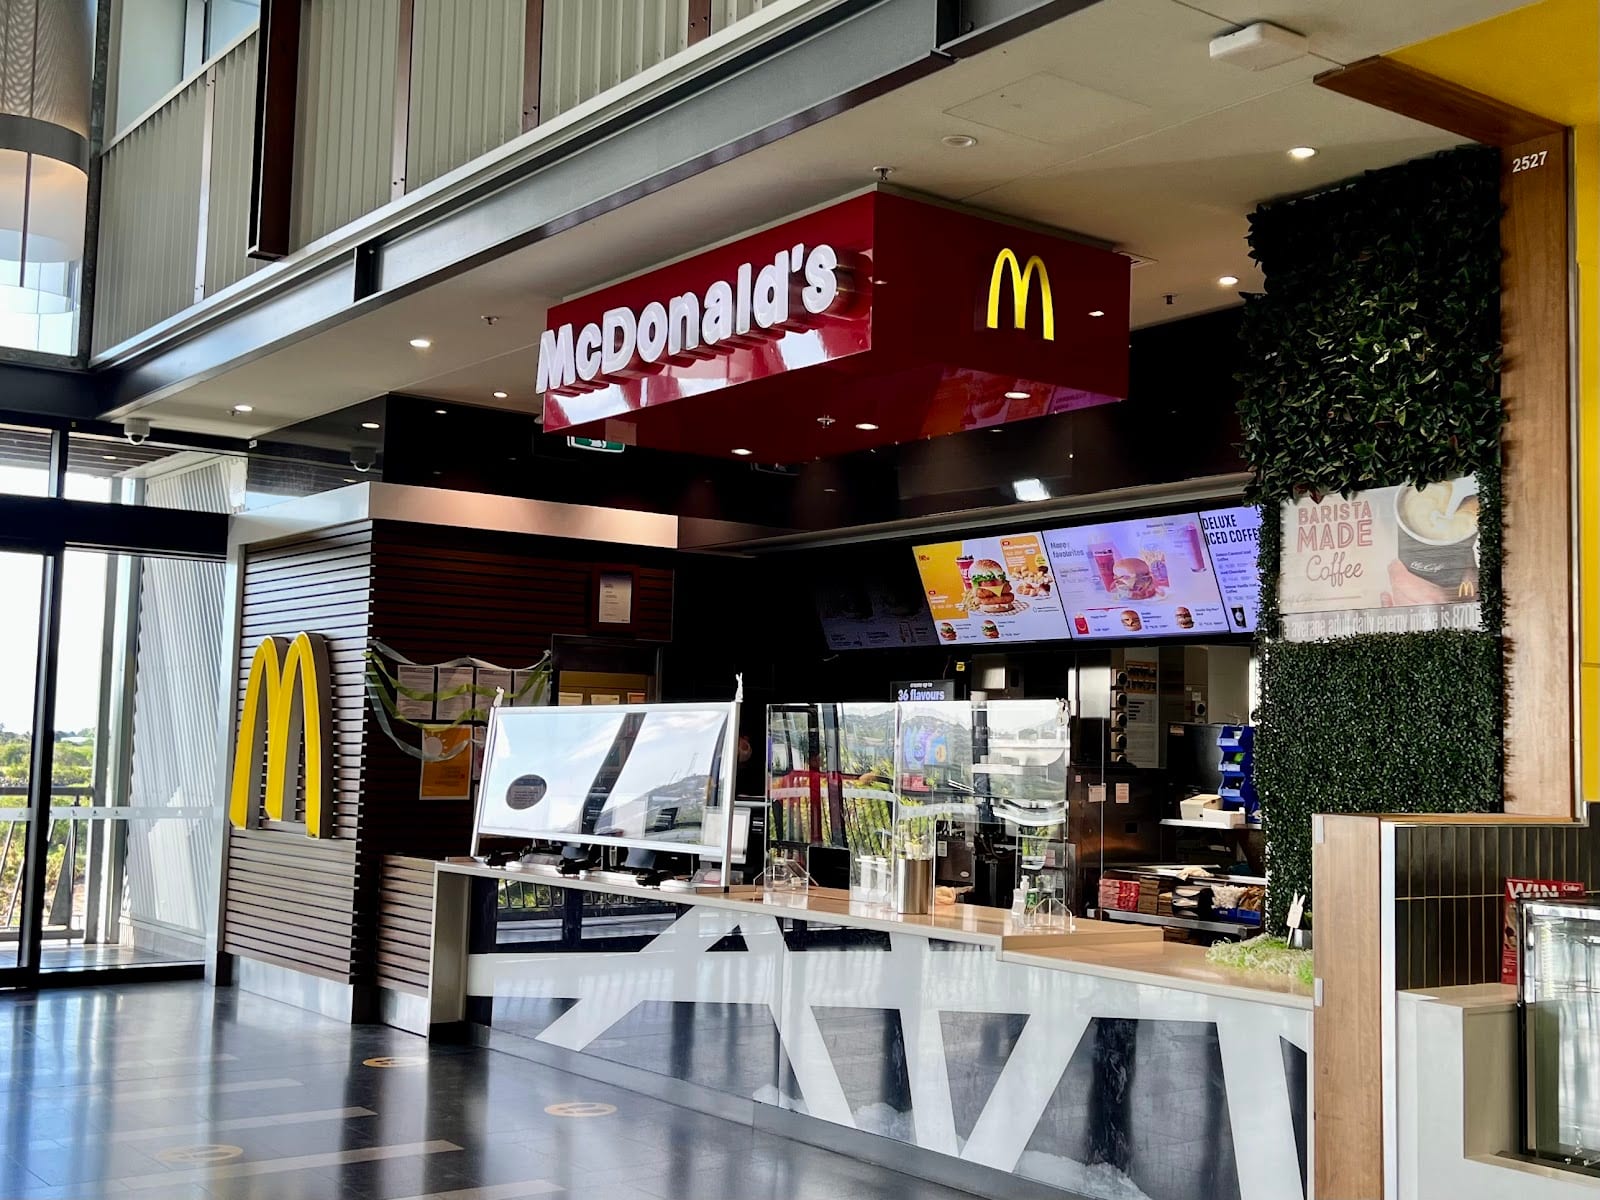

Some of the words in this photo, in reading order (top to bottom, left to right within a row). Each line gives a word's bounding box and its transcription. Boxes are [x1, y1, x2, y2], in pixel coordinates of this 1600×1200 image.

[1512, 150, 1548, 173] 2527
[535, 243, 838, 394] McDonald's
[1202, 514, 1238, 530] DELUXE
[1298, 500, 1372, 525] BARISTA
[1205, 531, 1228, 545] ICED
[1297, 519, 1373, 552] MADE
[1306, 551, 1363, 588] Coffee
[1441, 606, 1450, 629] is
[897, 689, 909, 701] 36
[910, 688, 945, 701] flavours
[1507, 881, 1560, 899] WIN
